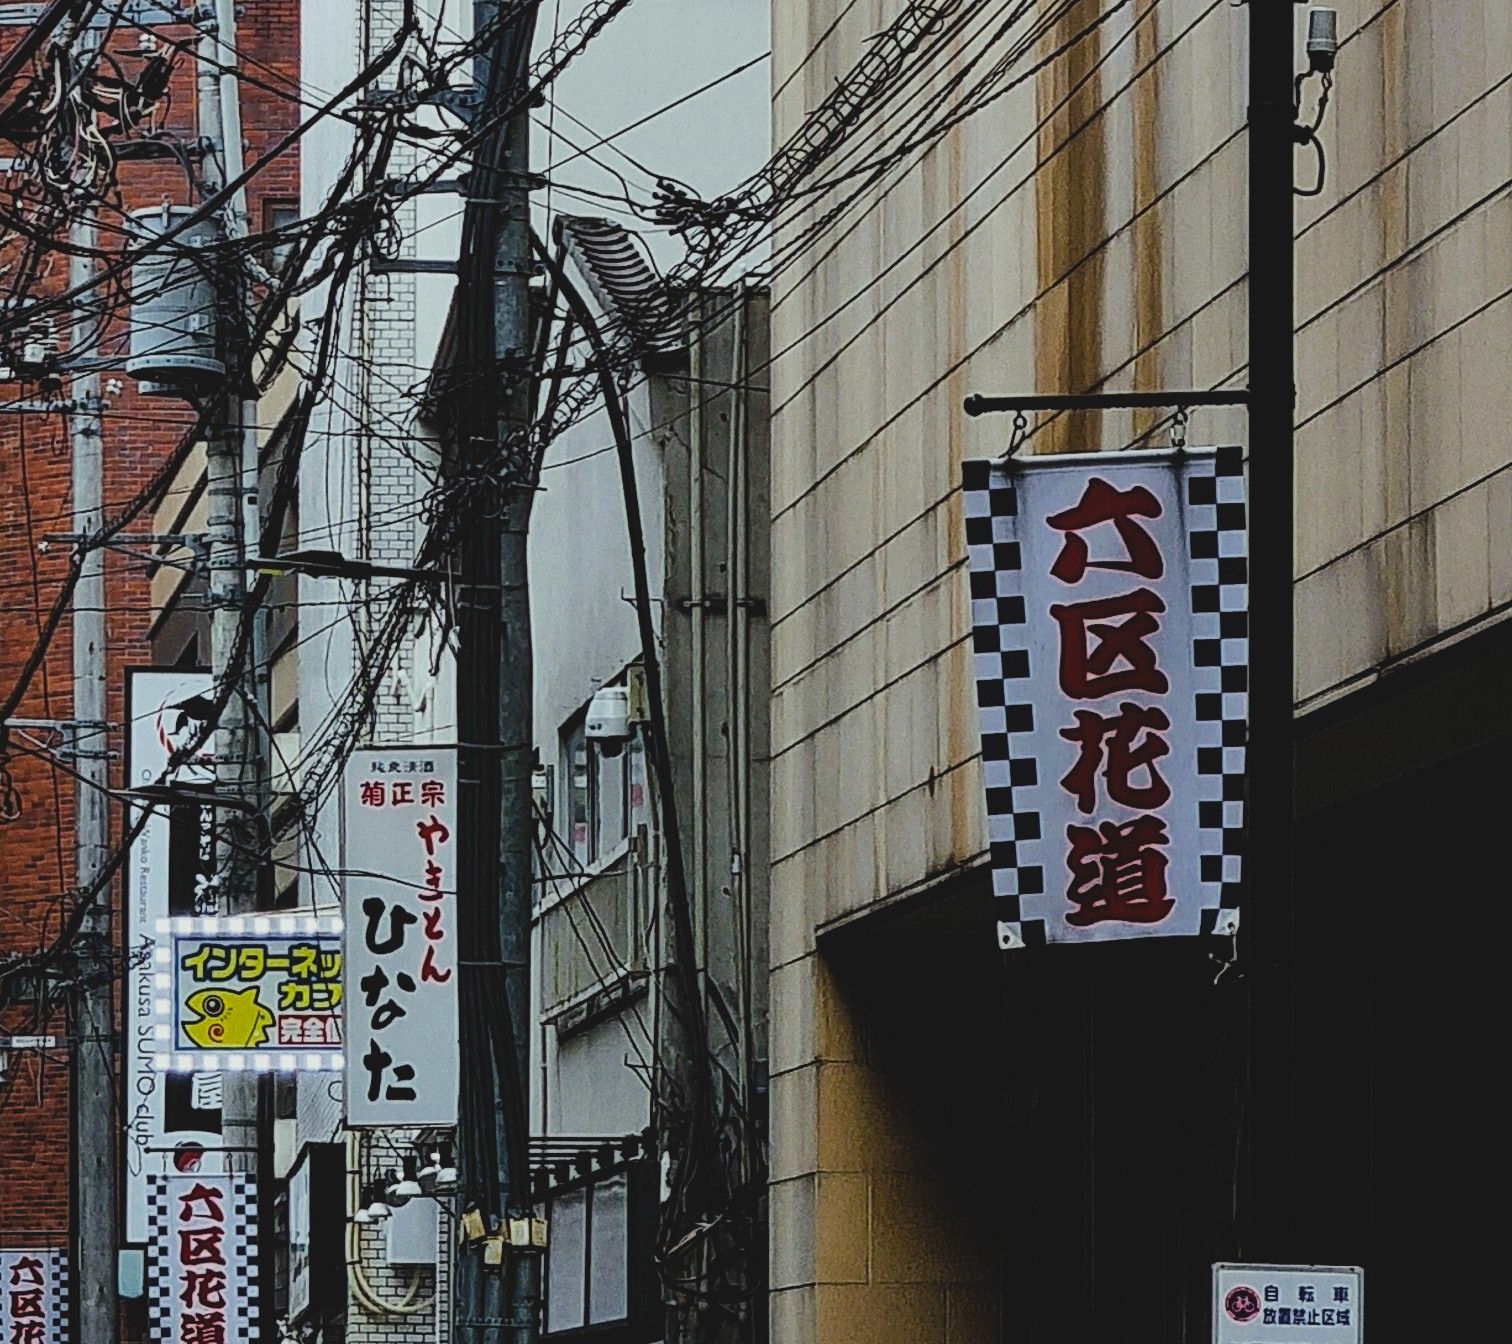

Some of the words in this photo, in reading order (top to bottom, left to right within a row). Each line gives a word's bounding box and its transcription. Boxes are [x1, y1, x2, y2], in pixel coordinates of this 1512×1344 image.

[1045, 477, 1175, 927] 六区花道
[360, 779, 445, 808] 菊正宗
[416, 814, 453, 984] やきとん
[138, 933, 156, 1016] Asakusa
[360, 896, 418, 1103] ひなた
[137, 1025, 156, 1096] SUMO
[135, 1103, 155, 1146] club
[1263, 1308, 1350, 1325] 放置禁止区域
[1264, 1285, 1349, 1303] 自転車
